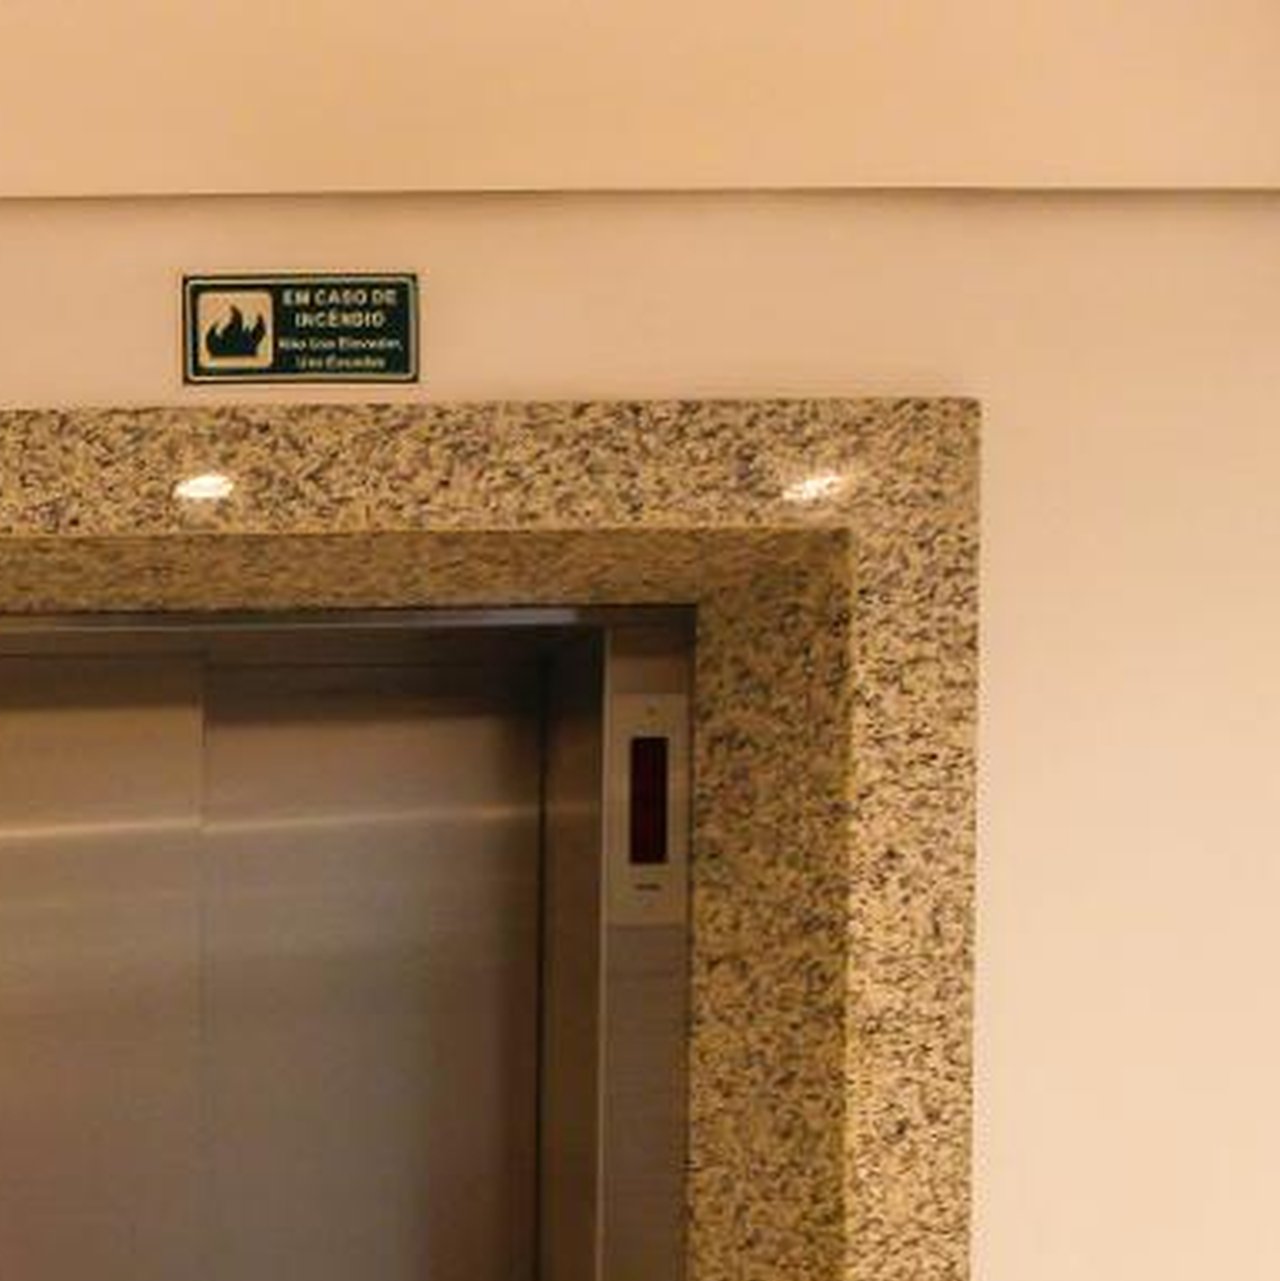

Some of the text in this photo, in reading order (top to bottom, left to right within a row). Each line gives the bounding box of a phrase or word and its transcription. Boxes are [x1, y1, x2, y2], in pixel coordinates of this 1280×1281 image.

[283, 288, 398, 306] EM CASO DE
